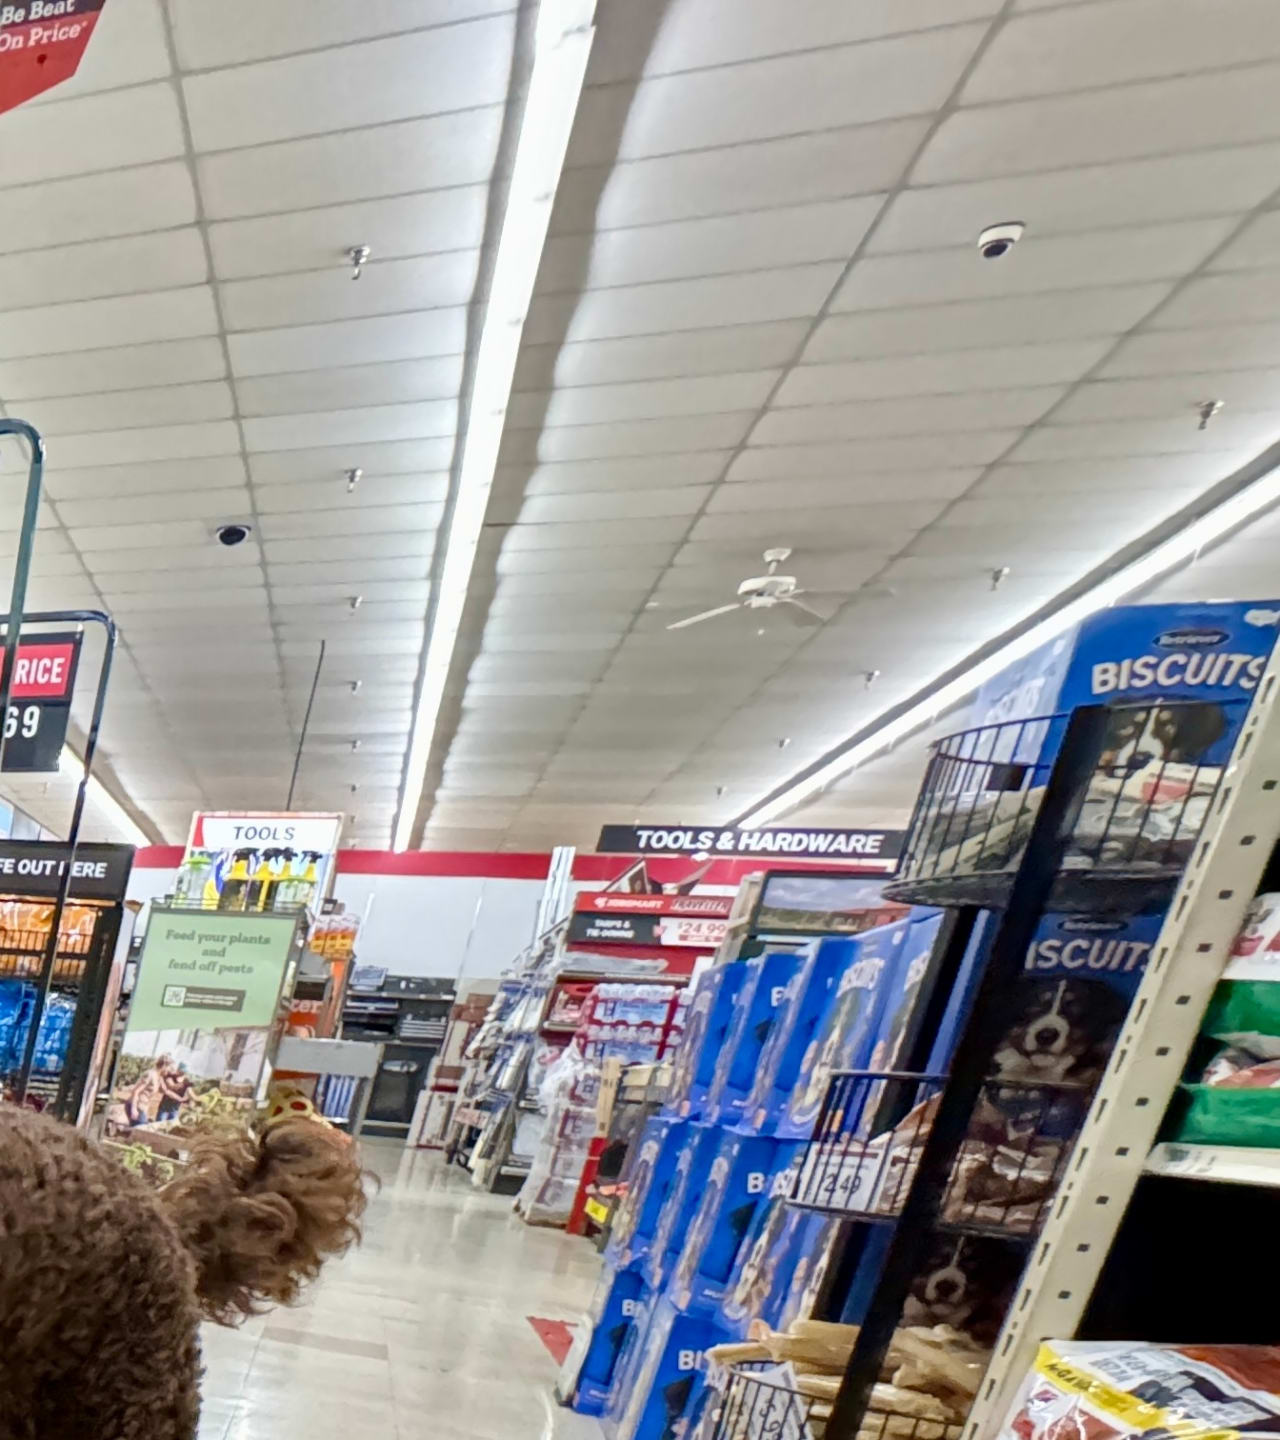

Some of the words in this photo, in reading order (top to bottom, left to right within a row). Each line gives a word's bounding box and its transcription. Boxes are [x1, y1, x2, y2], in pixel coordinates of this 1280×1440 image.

[0, 5, 26, 26] Be
[28, 0, 76, 20] Beat
[13, 656, 67, 686] RICE
[1092, 651, 1268, 696] BISCUITS
[233, 826, 295, 841] TOOLS
[636, 830, 715, 850] TOOLS
[716, 831, 735, 850] &
[738, 832, 885, 854] HARDWARE
[17, 859, 56, 877] OUT
[165, 929, 196, 941] Feed
[197, 932, 228, 945] your
[229, 931, 272, 946] plants
[201, 947, 227, 958] and
[1024, 938, 1152, 973] ISCUIT
